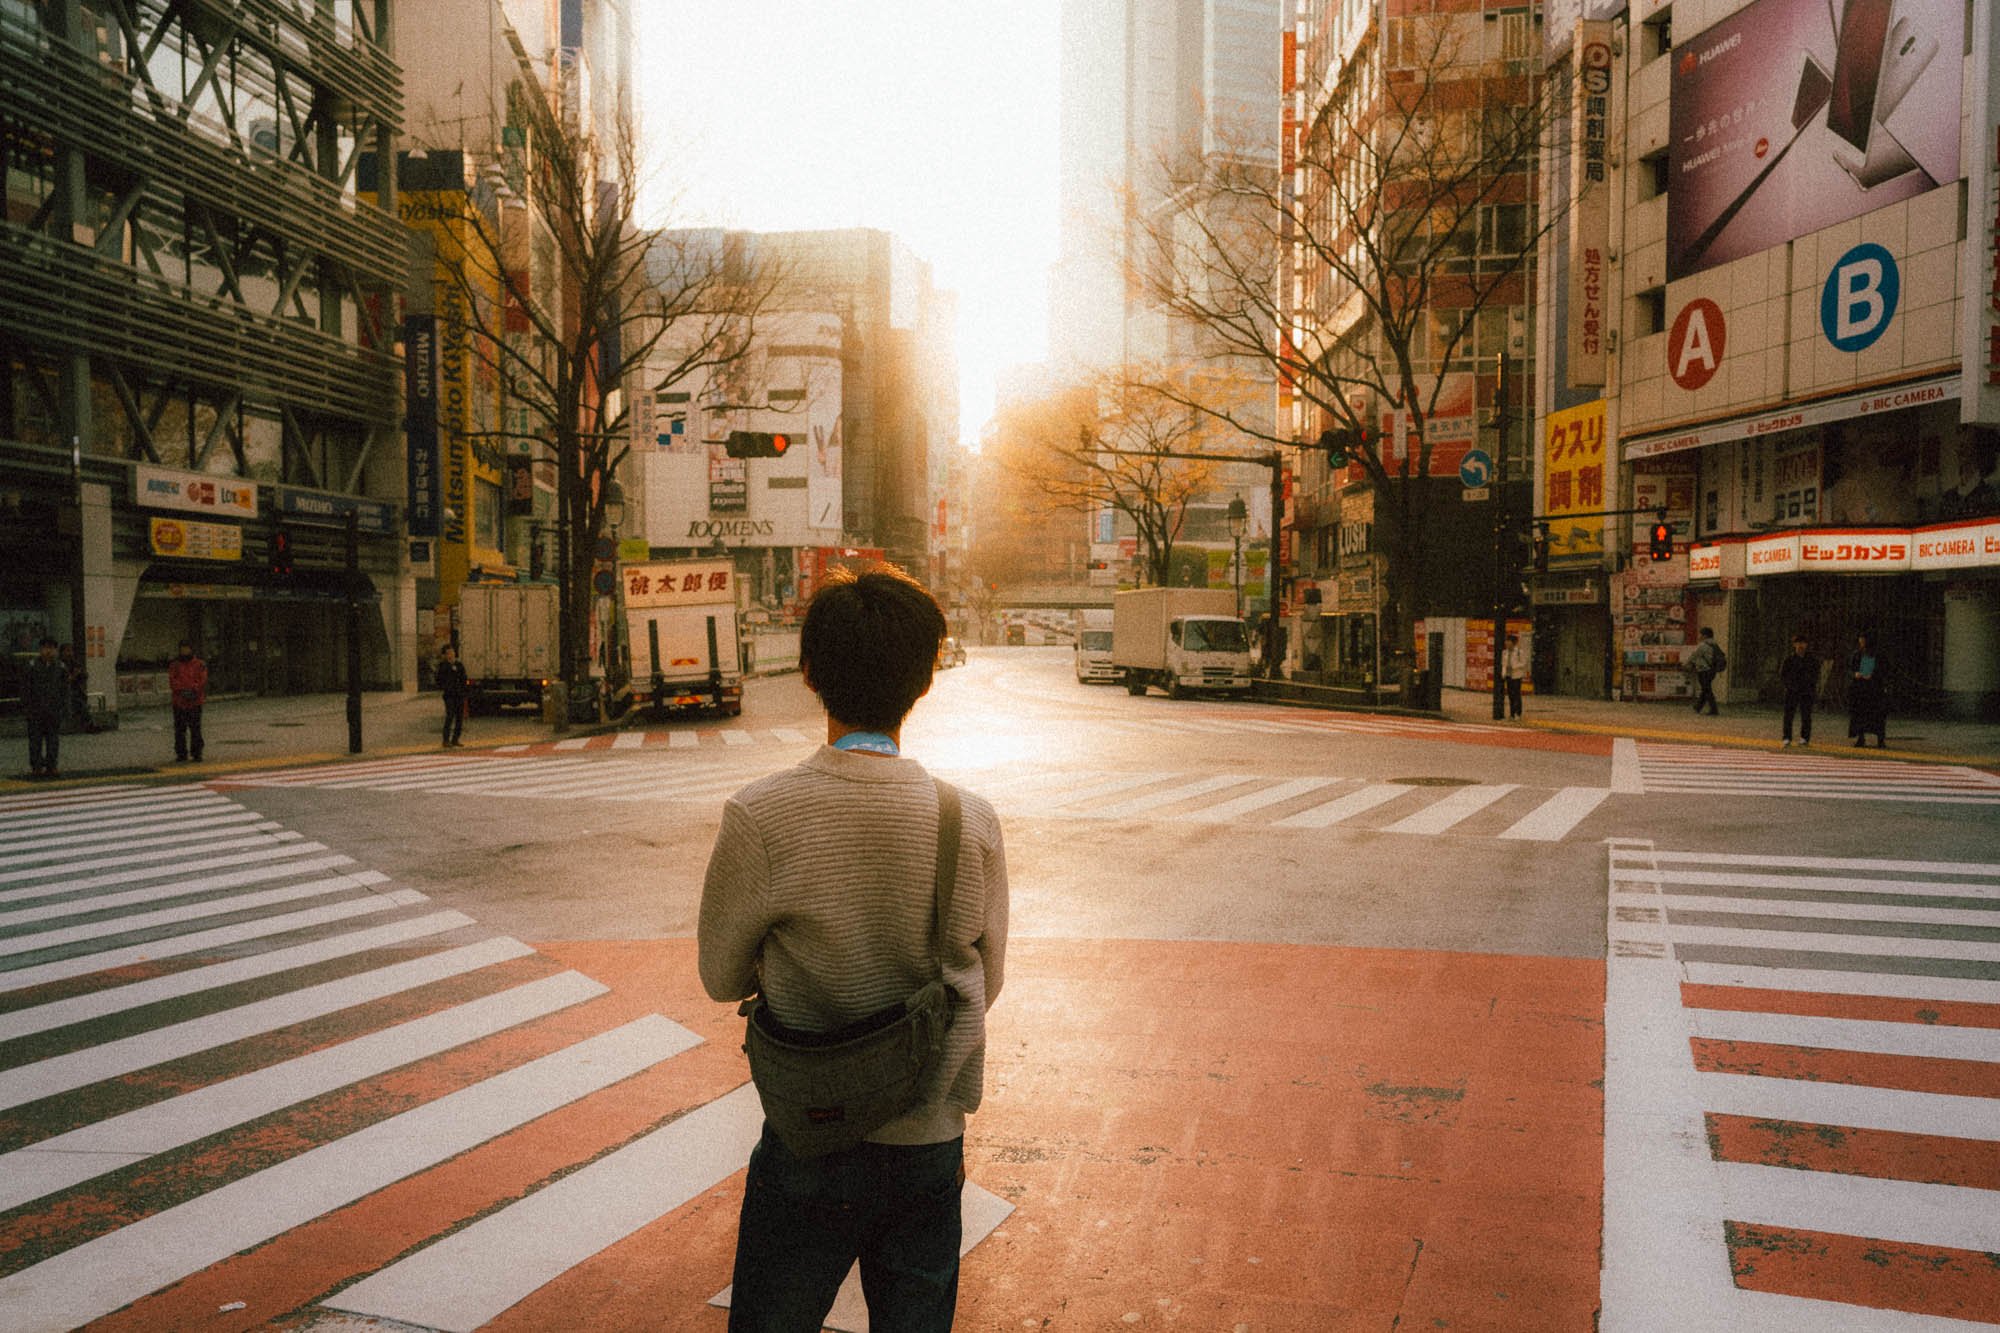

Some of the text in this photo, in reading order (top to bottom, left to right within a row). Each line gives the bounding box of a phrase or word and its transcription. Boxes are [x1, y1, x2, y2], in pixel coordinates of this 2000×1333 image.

[1699, 33, 1741, 65] HUAWEI
[1682, 147, 1721, 173] HUAWEI
[1584, 249, 1601, 355] 処方せん受付
[1836, 258, 1884, 341] B
[1676, 308, 1715, 378] A
[416, 332, 430, 398] MIZUHO
[1873, 387, 1944, 410] BIC CAMERA
[1757, 414, 1802, 432] ビックカメラ
[1551, 415, 1603, 463] クスリ
[1667, 436, 1700, 450] CAMERA
[1549, 464, 1603, 513] 調剤
[1340, 522, 1366, 553] LUSH
[1919, 539, 1976, 557] BIC CAMERA
[1752, 547, 1792, 564] BIC CAMERA
[1802, 544, 1906, 561] ビックカメラ
[630, 571, 729, 596] 桃太郎便
